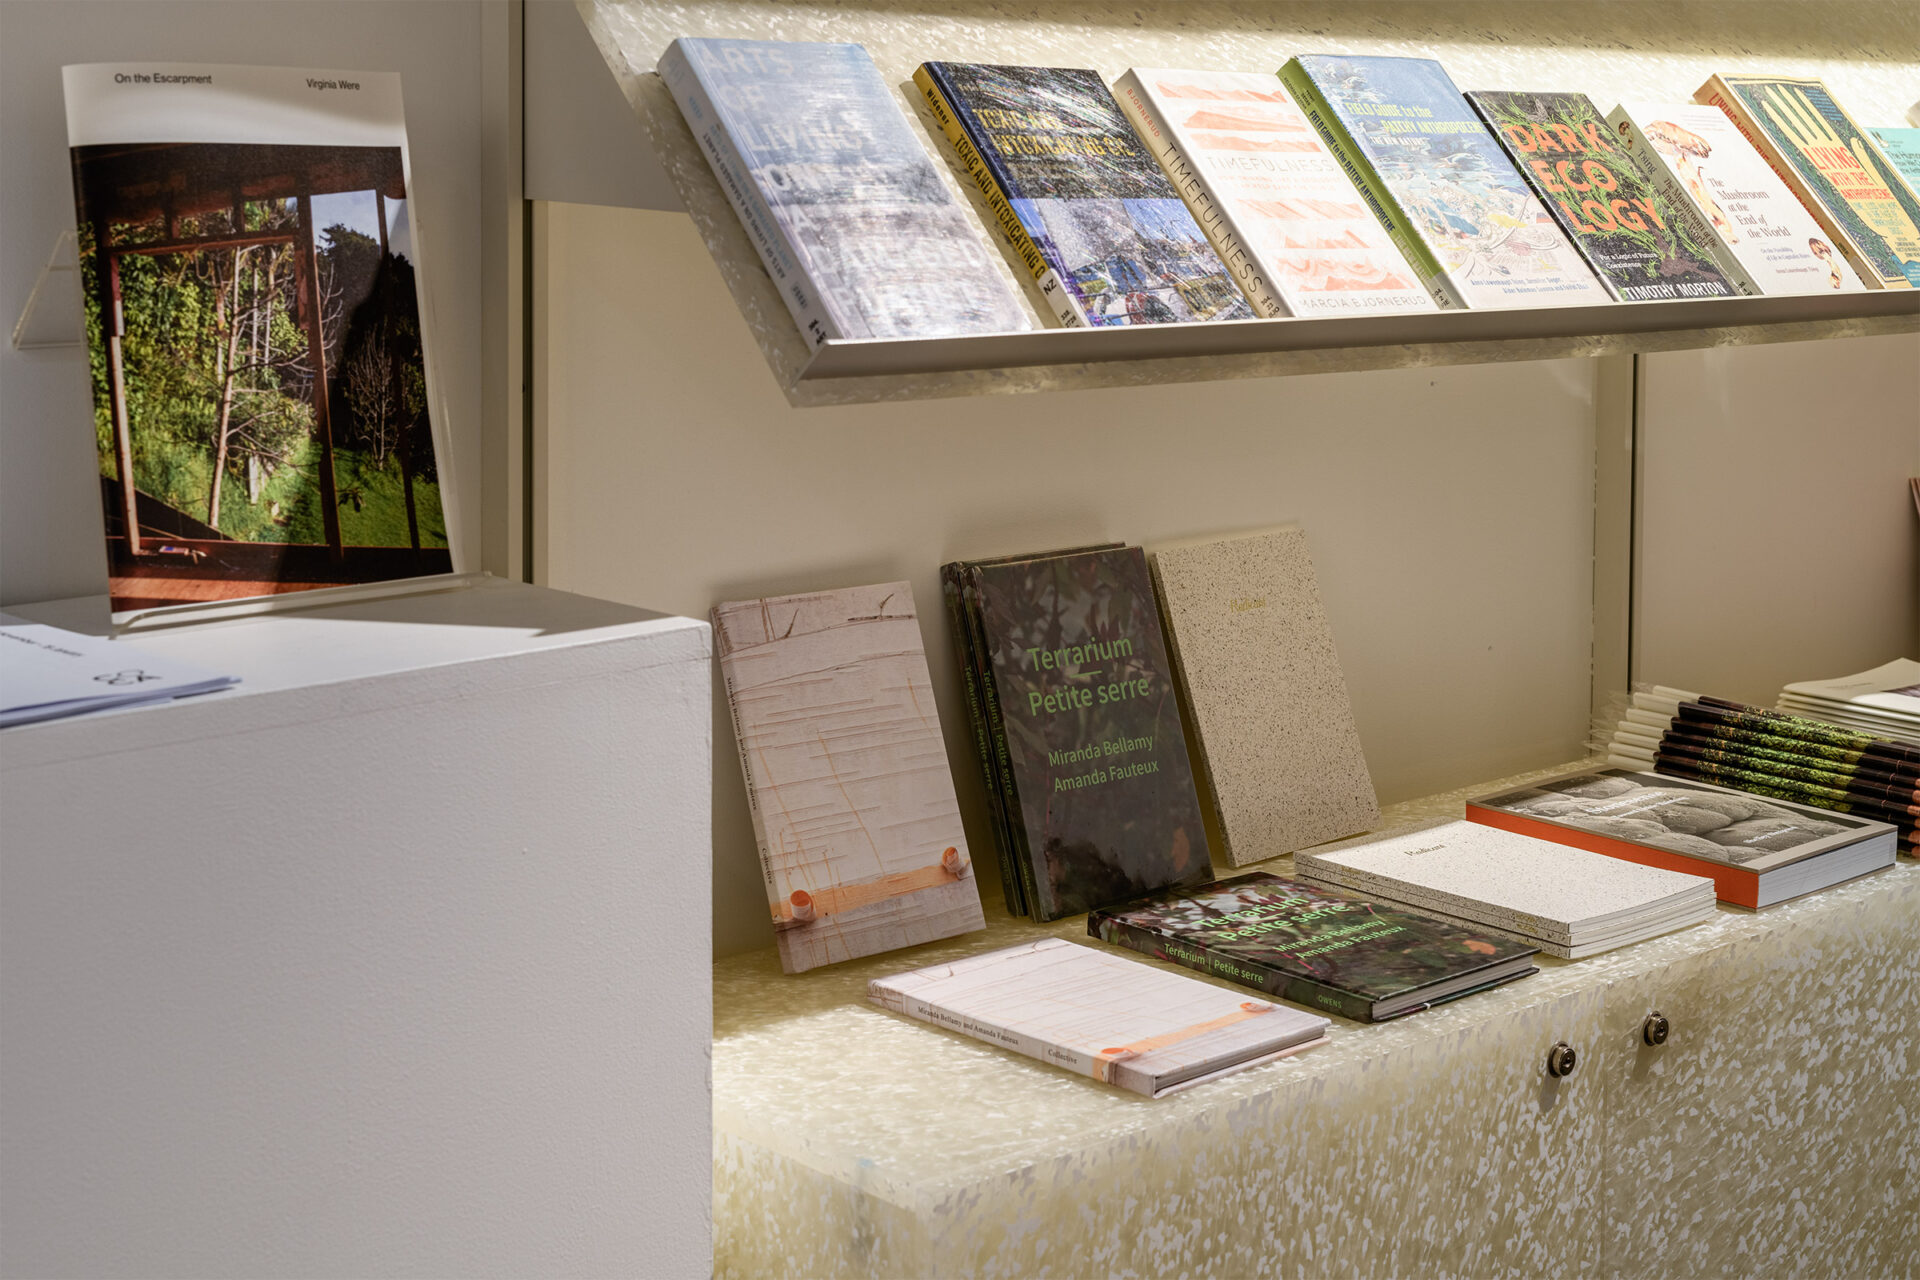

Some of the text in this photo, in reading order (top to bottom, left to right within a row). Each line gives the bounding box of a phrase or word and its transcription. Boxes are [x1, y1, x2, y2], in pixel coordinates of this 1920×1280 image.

[700, 47, 793, 73] ARTS
[114, 73, 212, 86] On the Escarpment
[306, 78, 360, 91] Virginia Were
[972, 109, 1026, 129] TOXIC
[1126, 88, 1160, 138] BJORNERUD
[1344, 102, 1375, 115] FIELD
[1501, 122, 1615, 153] DARK
[1309, 110, 1396, 233] FIELD GUIDE to the PATCHY ANTHROPOCENE
[1637, 148, 1657, 175] Tsing
[1803, 147, 1861, 170] LIVING
[1529, 159, 1617, 193] ECO
[1707, 178, 1725, 187] The
[1826, 172, 1875, 187] WITH THE
[954, 134, 1039, 273] TOXIC AND INTOXICATING
[1717, 190, 1770, 200] Mushroom
[1728, 202, 1749, 212] at the
[1162, 142, 1264, 294] TIMEFULNESS
[1557, 198, 1666, 233] LOGY
[1661, 188, 1708, 248] End of the World
[1664, 178, 1719, 248] The Mushroom at the
[1736, 214, 1768, 226] End of
[1747, 226, 1792, 239] the World
[1043, 279, 1057, 295] NZ
[1352, 295, 1426, 308] BJORNERUD
[1623, 282, 1728, 300] TIMOTHY MORTON
[1027, 637, 1133, 672] Terrarium
[965, 666, 980, 724] Terrarium
[1028, 676, 1150, 717] Petite serre
[984, 671, 1014, 797] Terrarium Petite serre
[1048, 734, 1154, 767] Miranda Bellamy
[1053, 759, 1160, 793] Amanda Fauteux
[1197, 895, 1308, 931] Terrarium
[1220, 902, 1350, 944] Petite serre
[1273, 918, 1386, 954] Miranda Bellamy
[1295, 925, 1407, 961] Amanda Fauteux
[1164, 943, 1206, 967] Terrarium
[1213, 959, 1240, 979] Petite
[1240, 968, 1264, 985] serre
[1318, 995, 1342, 1010] OWENS
[917, 1006, 1019, 1047] Miranda Bellamy and Amanda Fauteux
[1047, 1048, 1078, 1065] Collective
